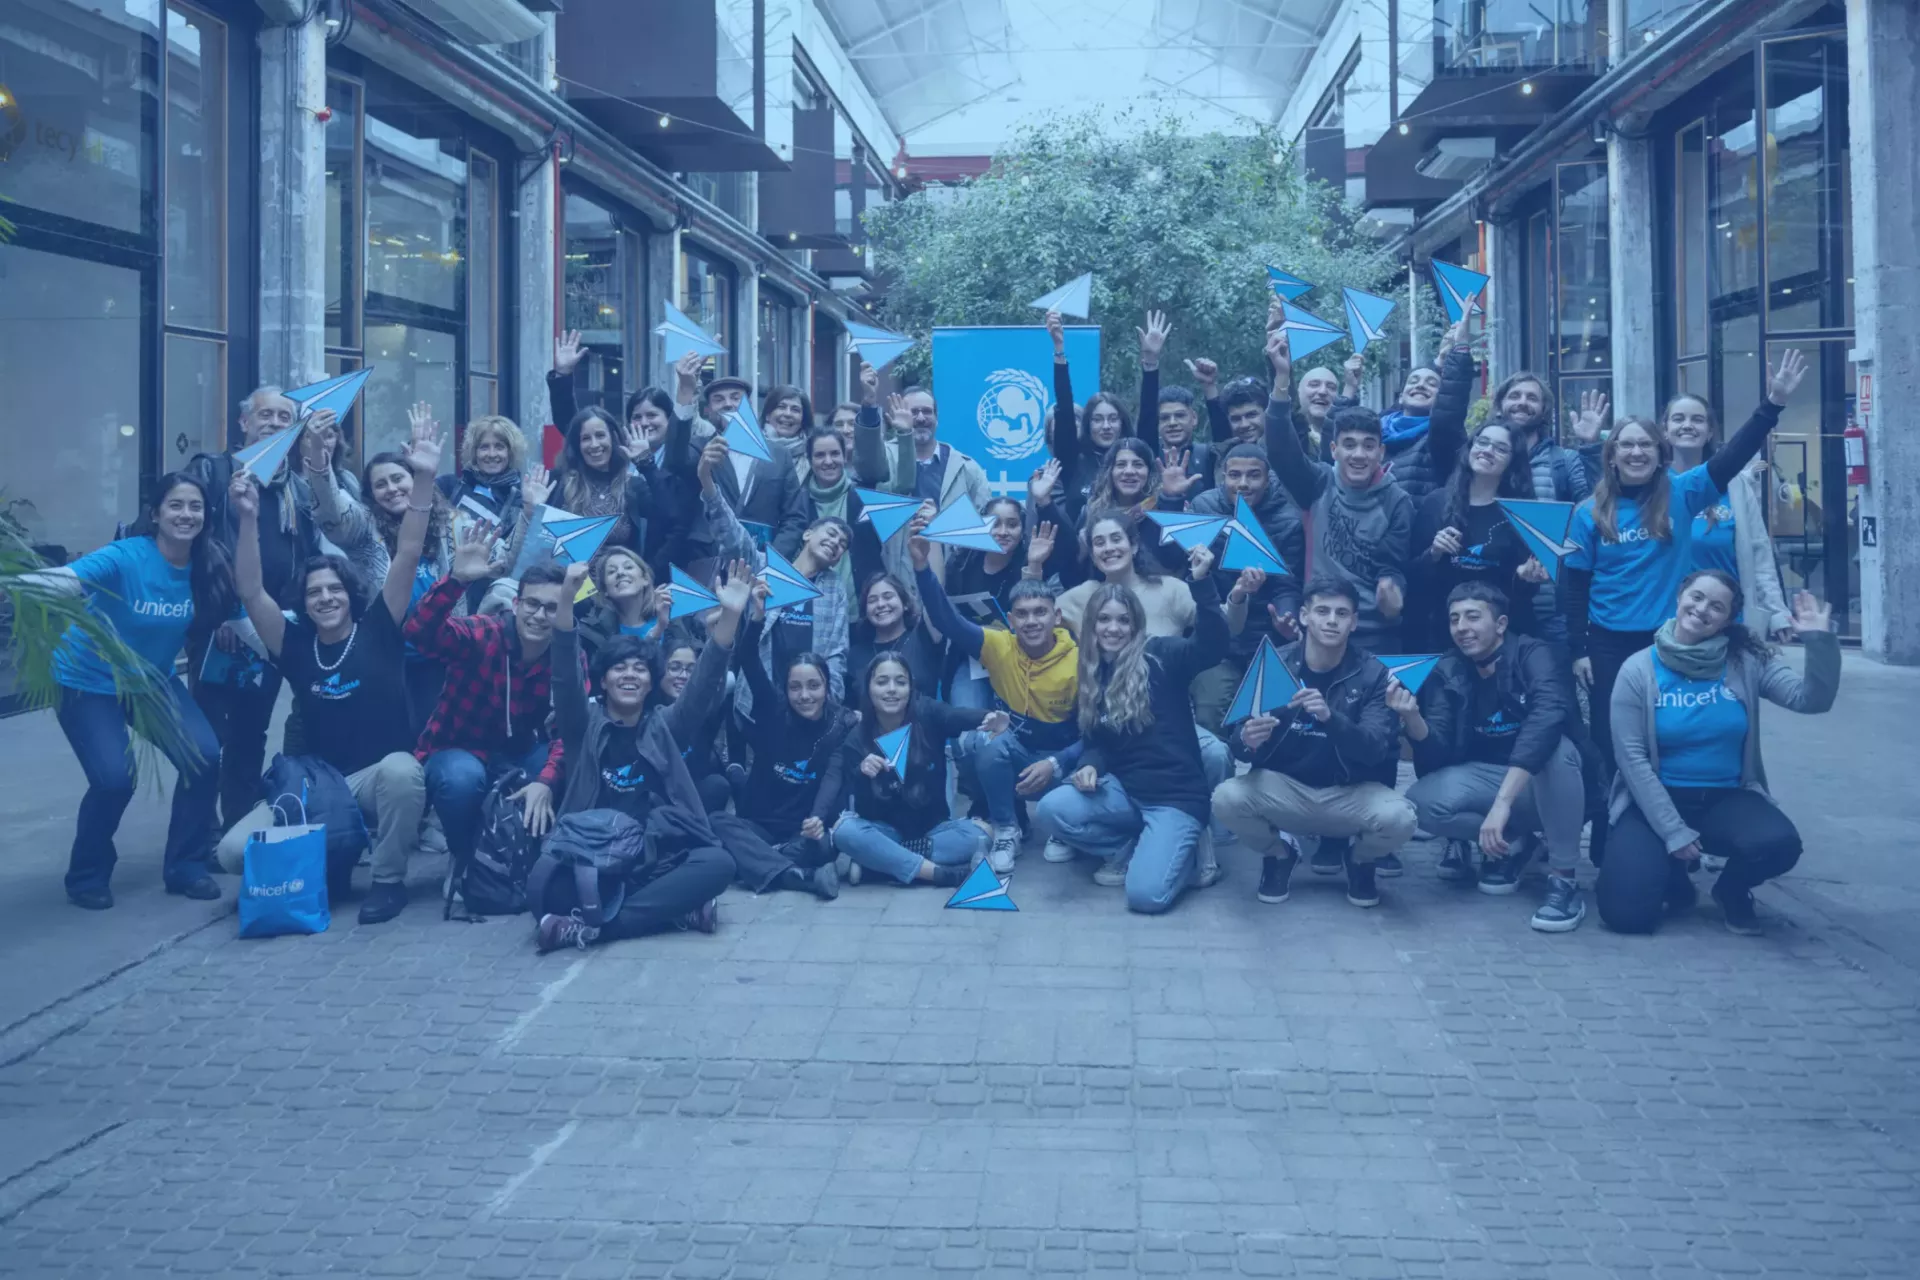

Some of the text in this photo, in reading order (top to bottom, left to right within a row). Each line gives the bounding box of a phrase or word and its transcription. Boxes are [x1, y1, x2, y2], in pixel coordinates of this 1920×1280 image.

[1601, 526, 1649, 546] uice
[133, 597, 190, 618] unicef
[248, 880, 288, 897] unicef
